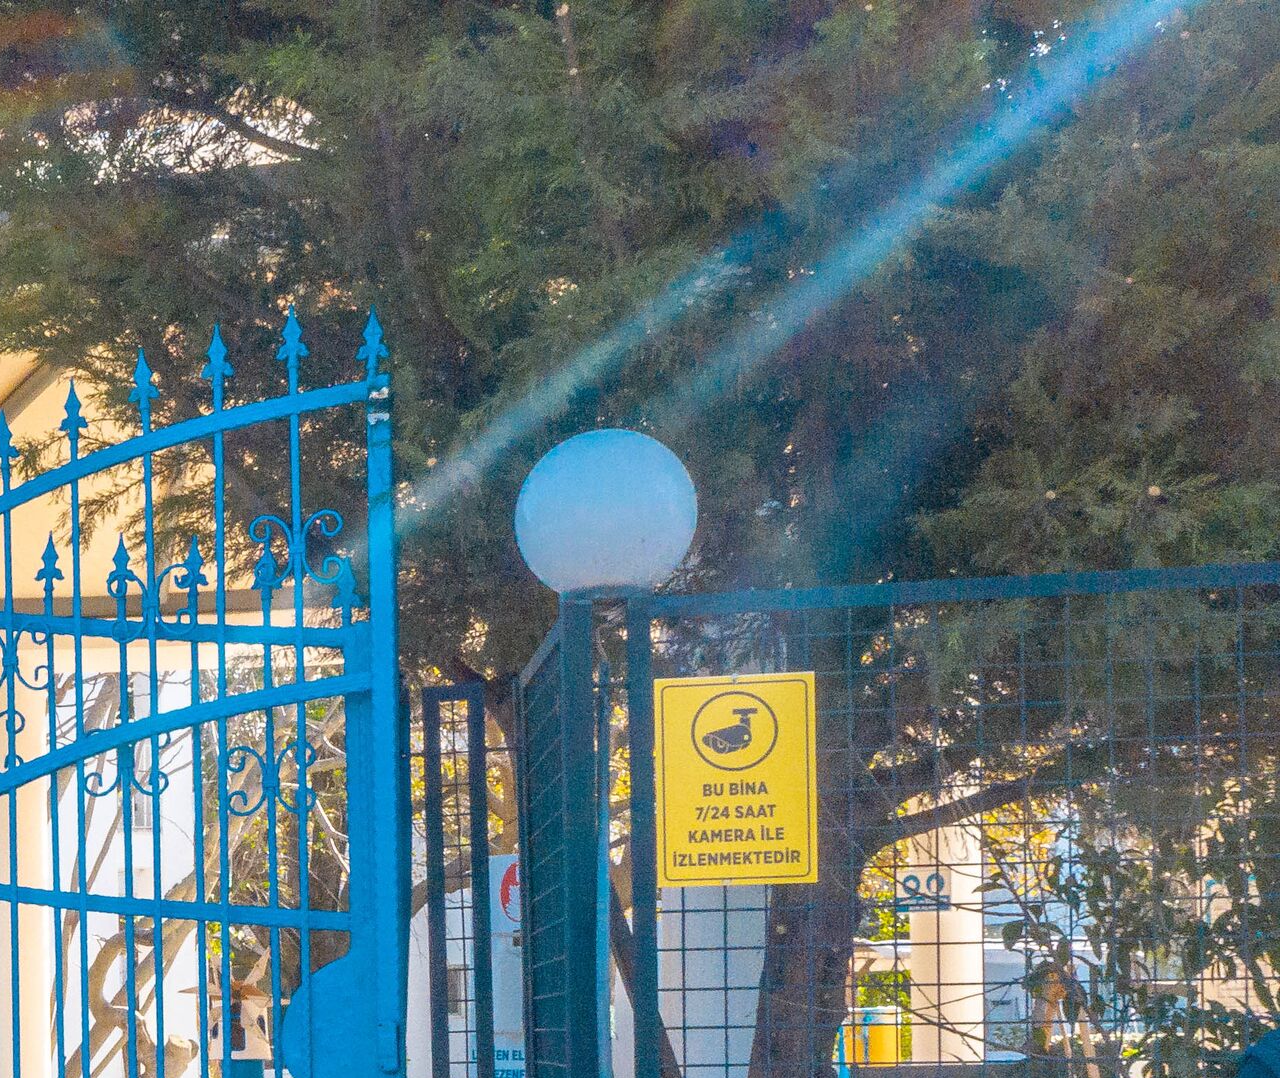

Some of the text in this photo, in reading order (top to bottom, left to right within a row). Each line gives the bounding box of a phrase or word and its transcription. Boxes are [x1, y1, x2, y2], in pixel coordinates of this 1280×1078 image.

[702, 780, 768, 797] BU BİNA
[695, 804, 776, 822] 7/24 SAAT
[688, 825, 784, 843] KAMERA İLE
[672, 848, 801, 867] İZLENMEKTEDİR
